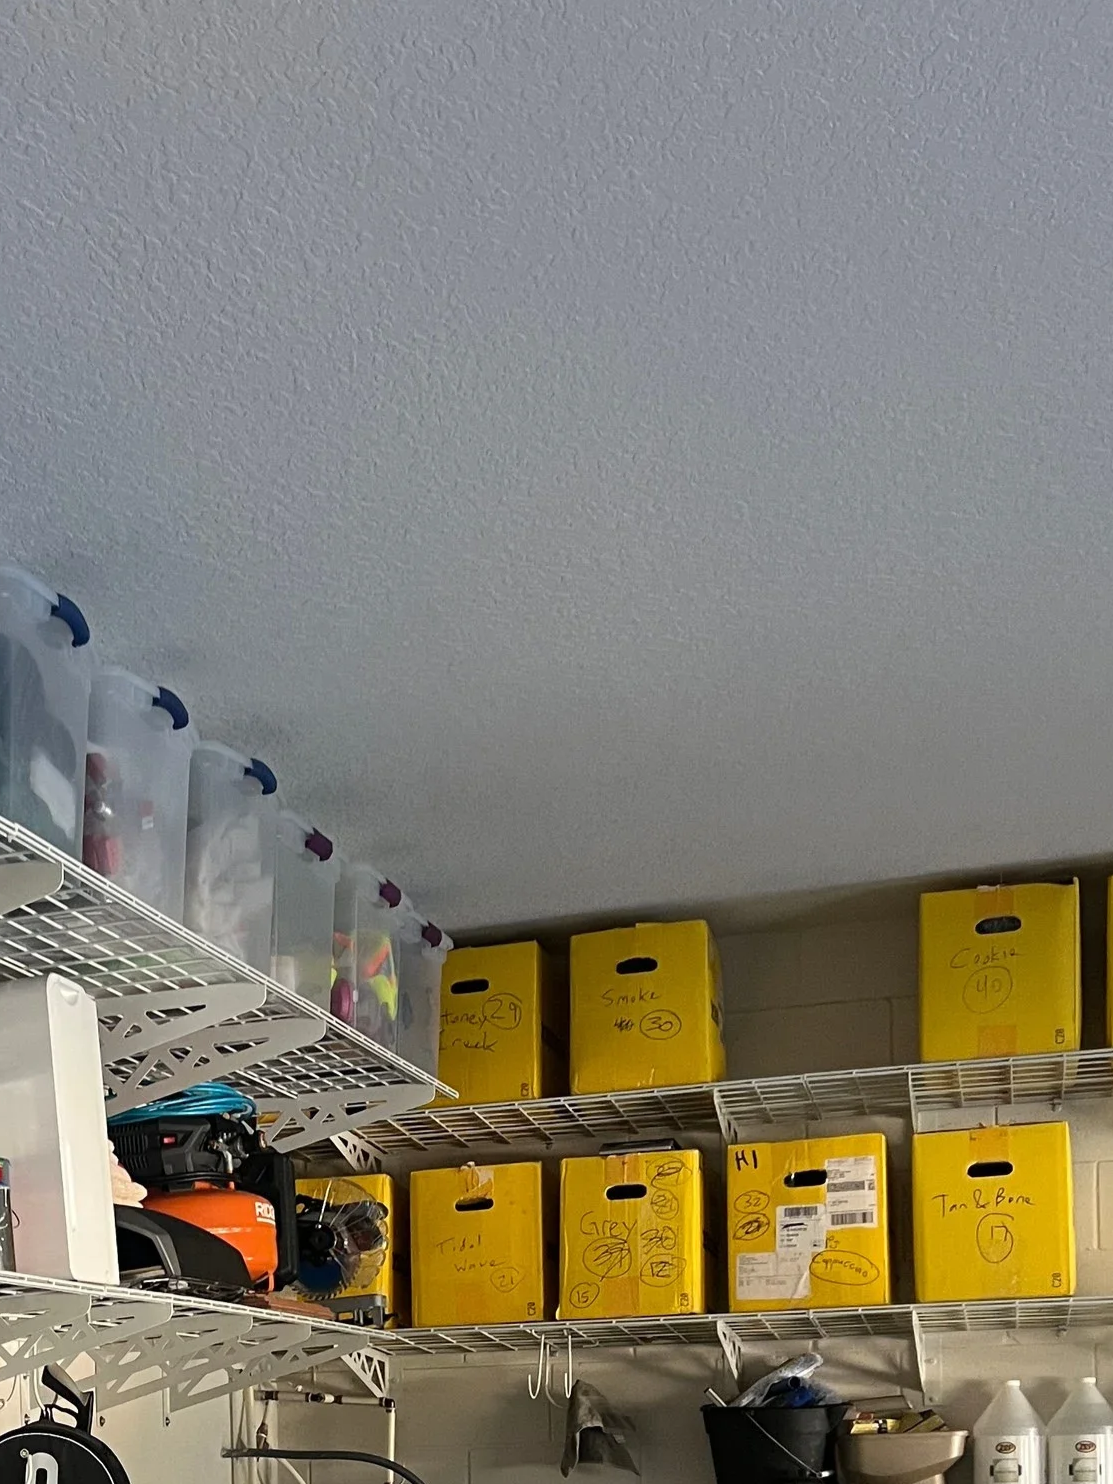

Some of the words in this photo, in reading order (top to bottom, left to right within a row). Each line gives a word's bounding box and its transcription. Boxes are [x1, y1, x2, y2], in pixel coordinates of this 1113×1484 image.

[976, 974, 1004, 998] 40
[440, 1008, 489, 1031] toney
[647, 1016, 675, 1033] 30
[932, 1194, 968, 1218] Tan
[973, 1189, 991, 1209] &
[995, 1187, 1036, 1206] Bone
[580, 1211, 637, 1243] Grey
[990, 1225, 1008, 1241] 17
[436, 1235, 482, 1254] Tidal
[576, 1290, 590, 1303] 15
